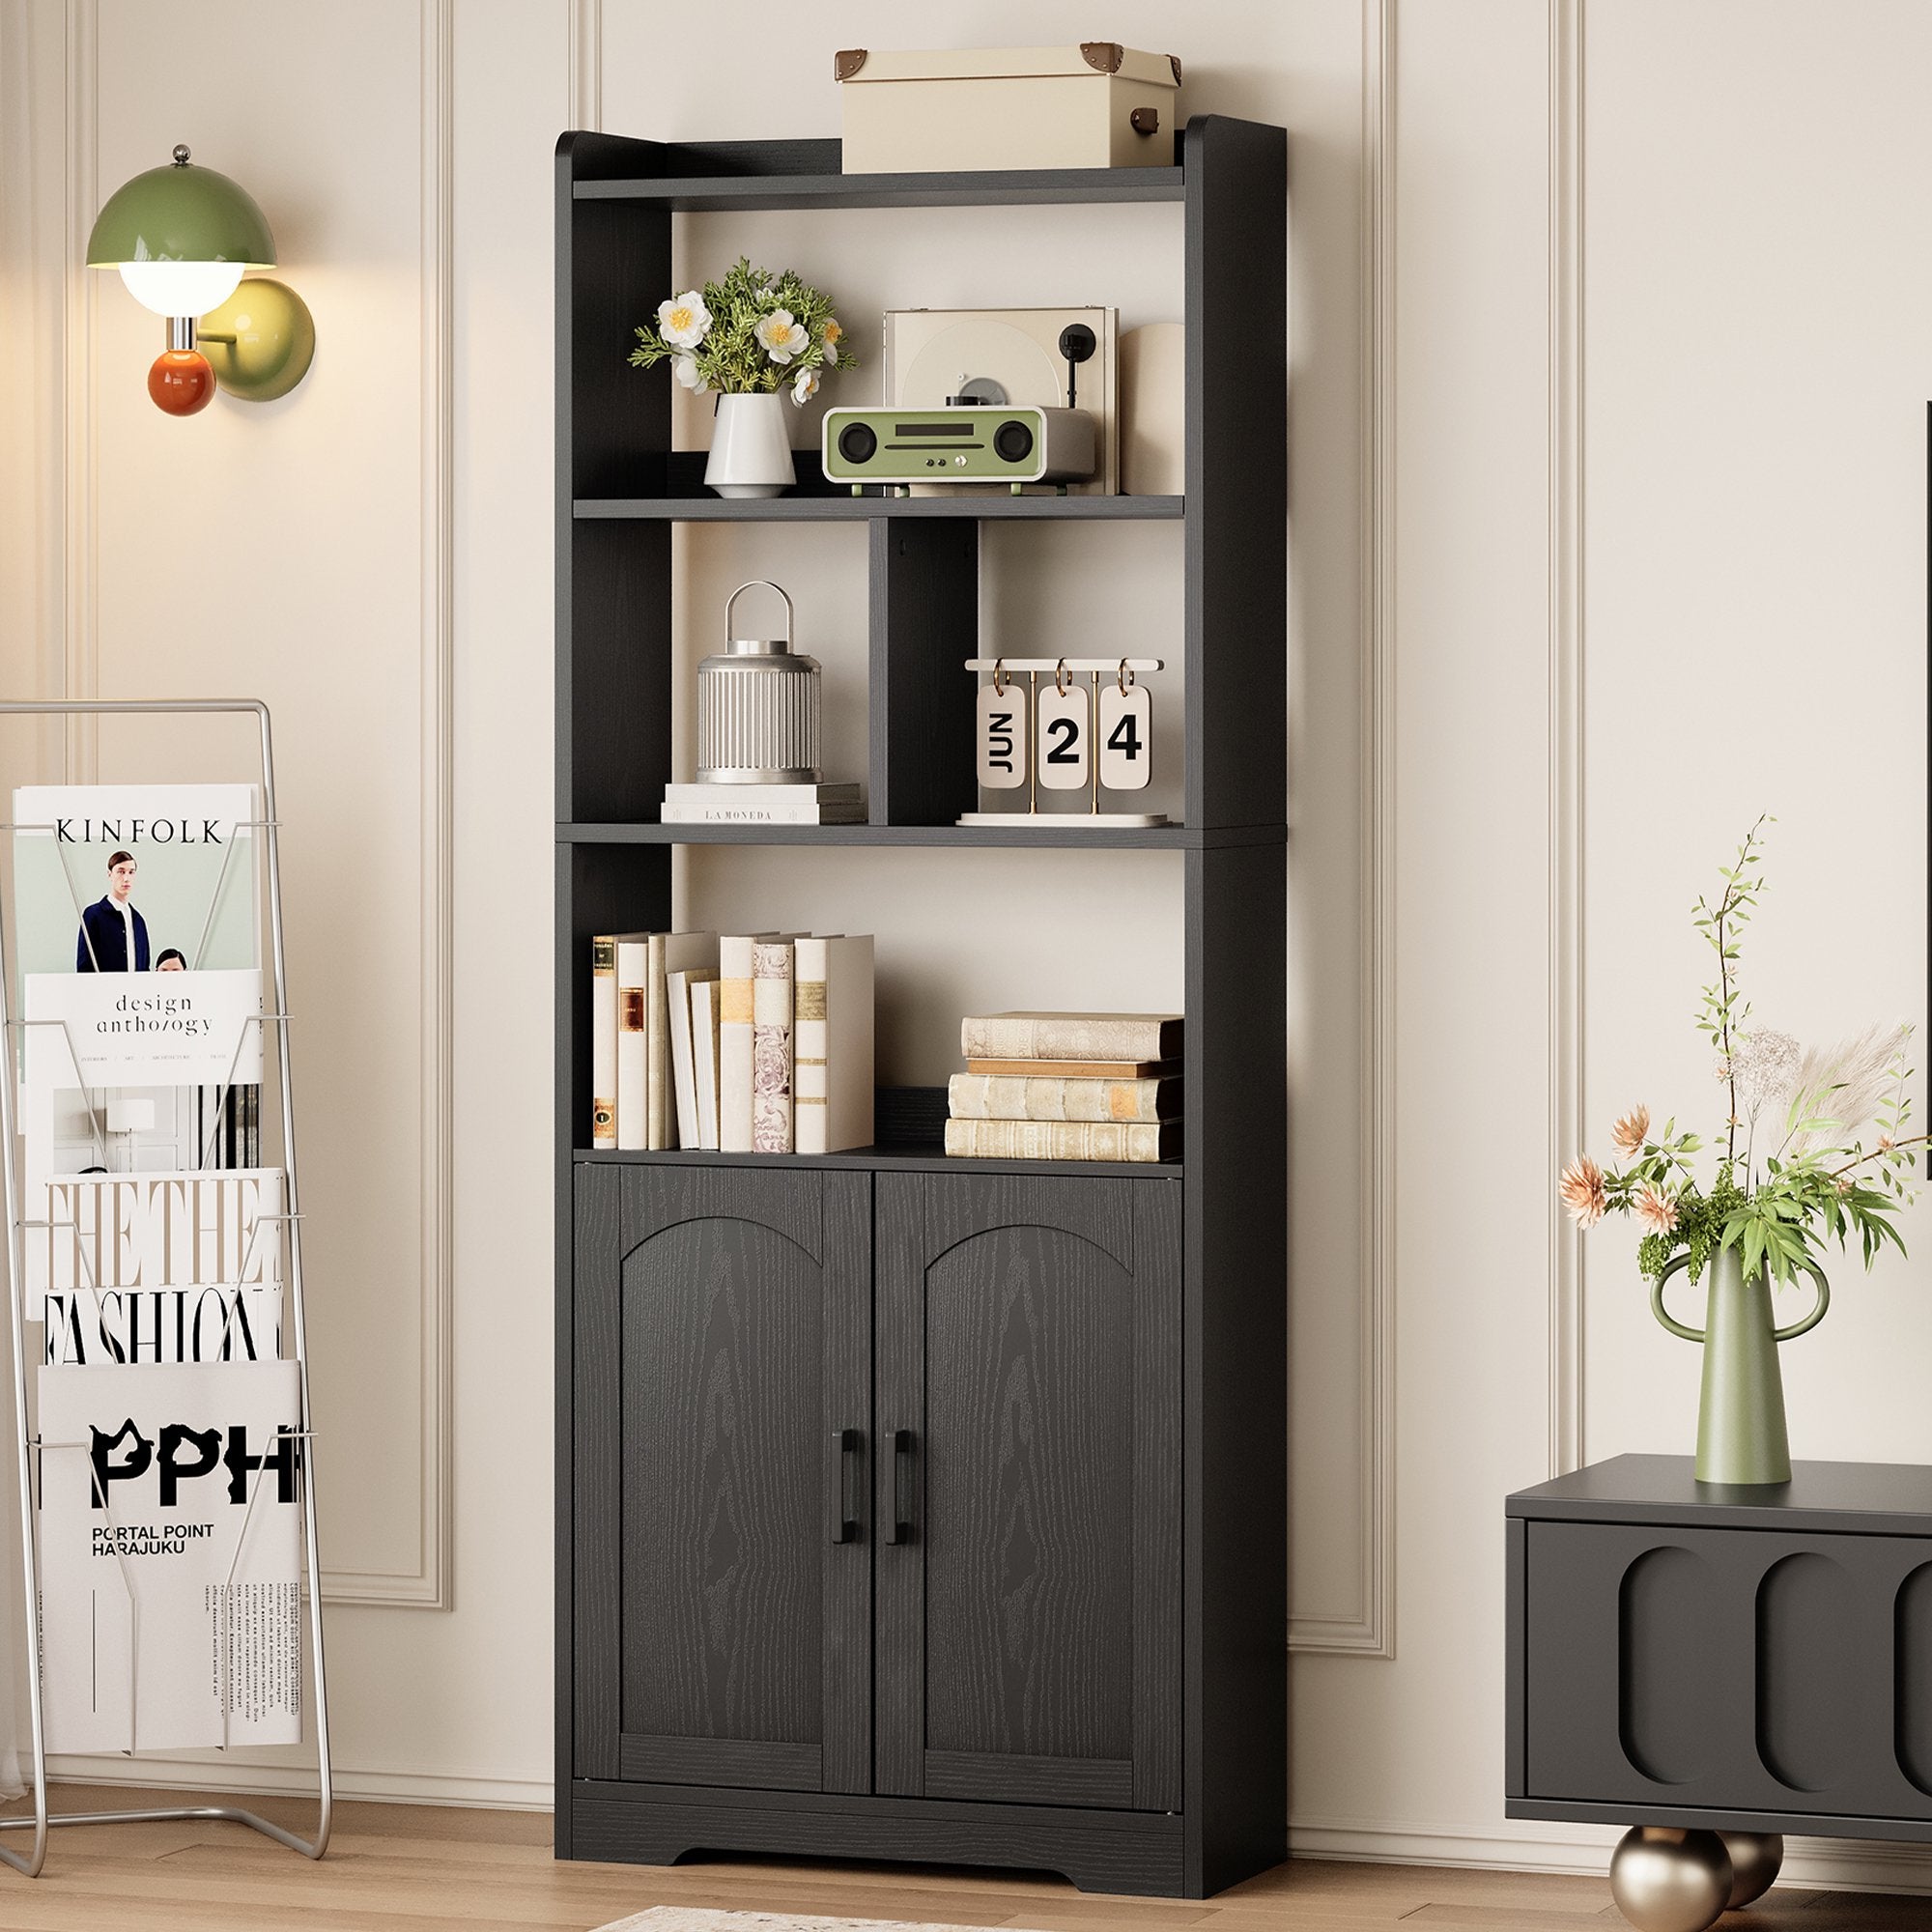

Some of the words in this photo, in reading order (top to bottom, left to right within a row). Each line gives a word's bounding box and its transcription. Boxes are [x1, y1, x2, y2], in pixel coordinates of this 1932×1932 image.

[988, 713, 1013, 773] JUN
[1047, 718, 1080, 764] 2
[1107, 714, 1142, 760] 4
[705, 811, 722, 820] LA
[724, 811, 771, 820] MONEDA
[56, 819, 223, 844] KINFOLK
[116, 994, 191, 1015] design
[149, 1178, 263, 1286] THE
[89, 1417, 299, 1509] PPH
[92, 1526, 159, 1541] PORTAL
[163, 1524, 214, 1539] POINT
[92, 1540, 185, 1556] HARAJUKU
